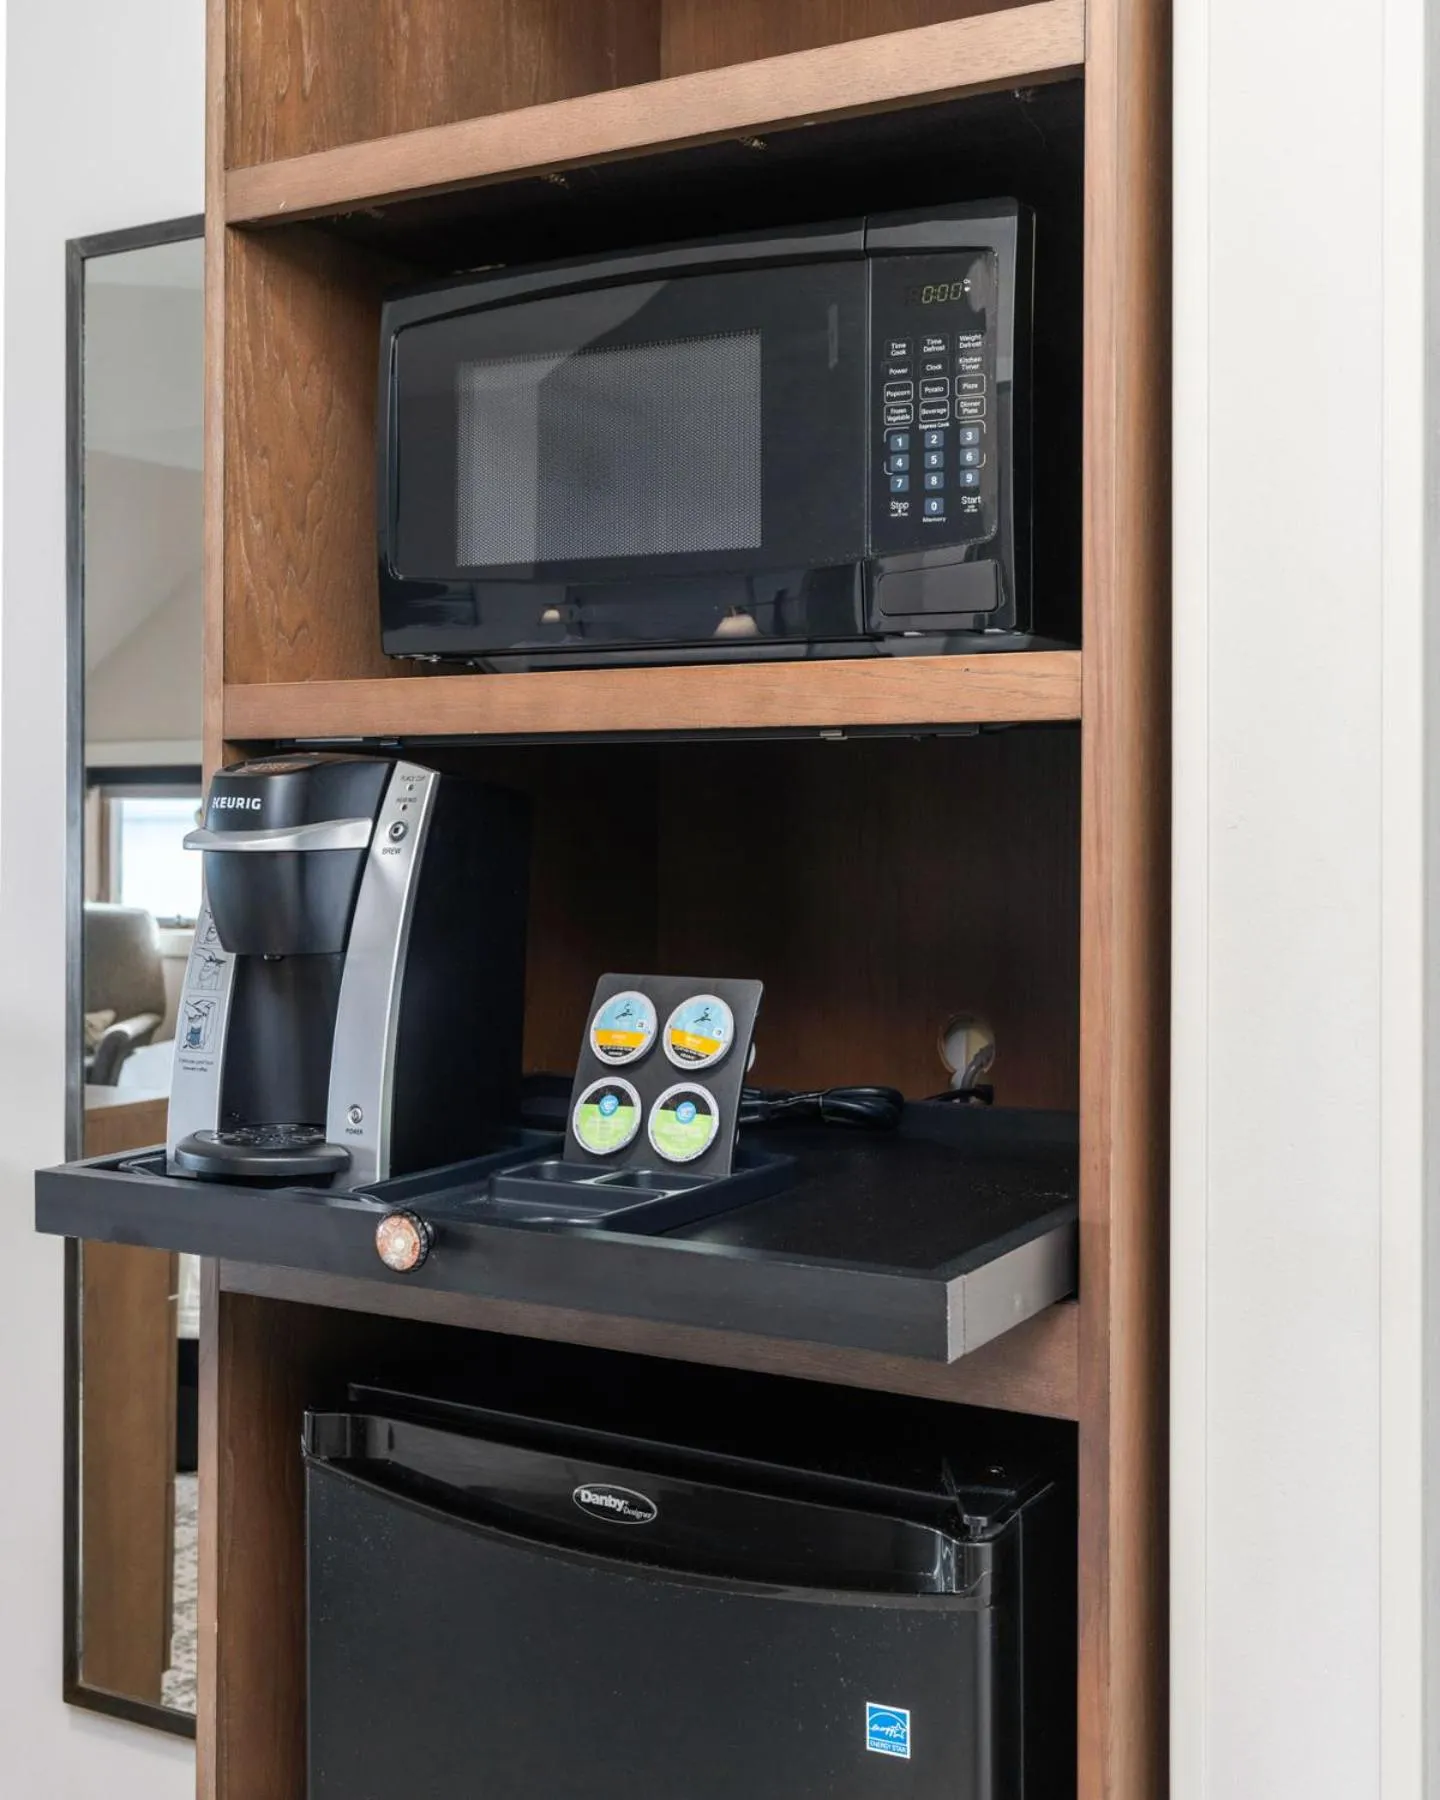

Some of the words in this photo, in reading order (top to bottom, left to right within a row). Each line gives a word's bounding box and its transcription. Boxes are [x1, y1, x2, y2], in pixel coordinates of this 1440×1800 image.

[922, 284, 963, 304] 0:00
[923, 345, 946, 353] Defrost
[886, 389, 911, 398] Popcorn
[921, 407, 947, 416] Beverage
[887, 414, 911, 422] Vegetable
[930, 435, 937, 444] 2
[966, 432, 973, 441] 3
[930, 455, 937, 465] 5
[966, 453, 973, 462] 6
[896, 458, 903, 467] 4
[930, 476, 937, 486] 8
[966, 473, 973, 483] 9
[896, 479, 903, 488] 7
[961, 496, 982, 505] Start
[890, 501, 909, 511] Stop
[930, 502, 937, 511] 0
[211, 796, 262, 811] KEURIG
[382, 847, 402, 856] BREW
[345, 1128, 364, 1136] POWER
[581, 1490, 625, 1512] Danby
[870, 1740, 892, 1750] ENERGY
